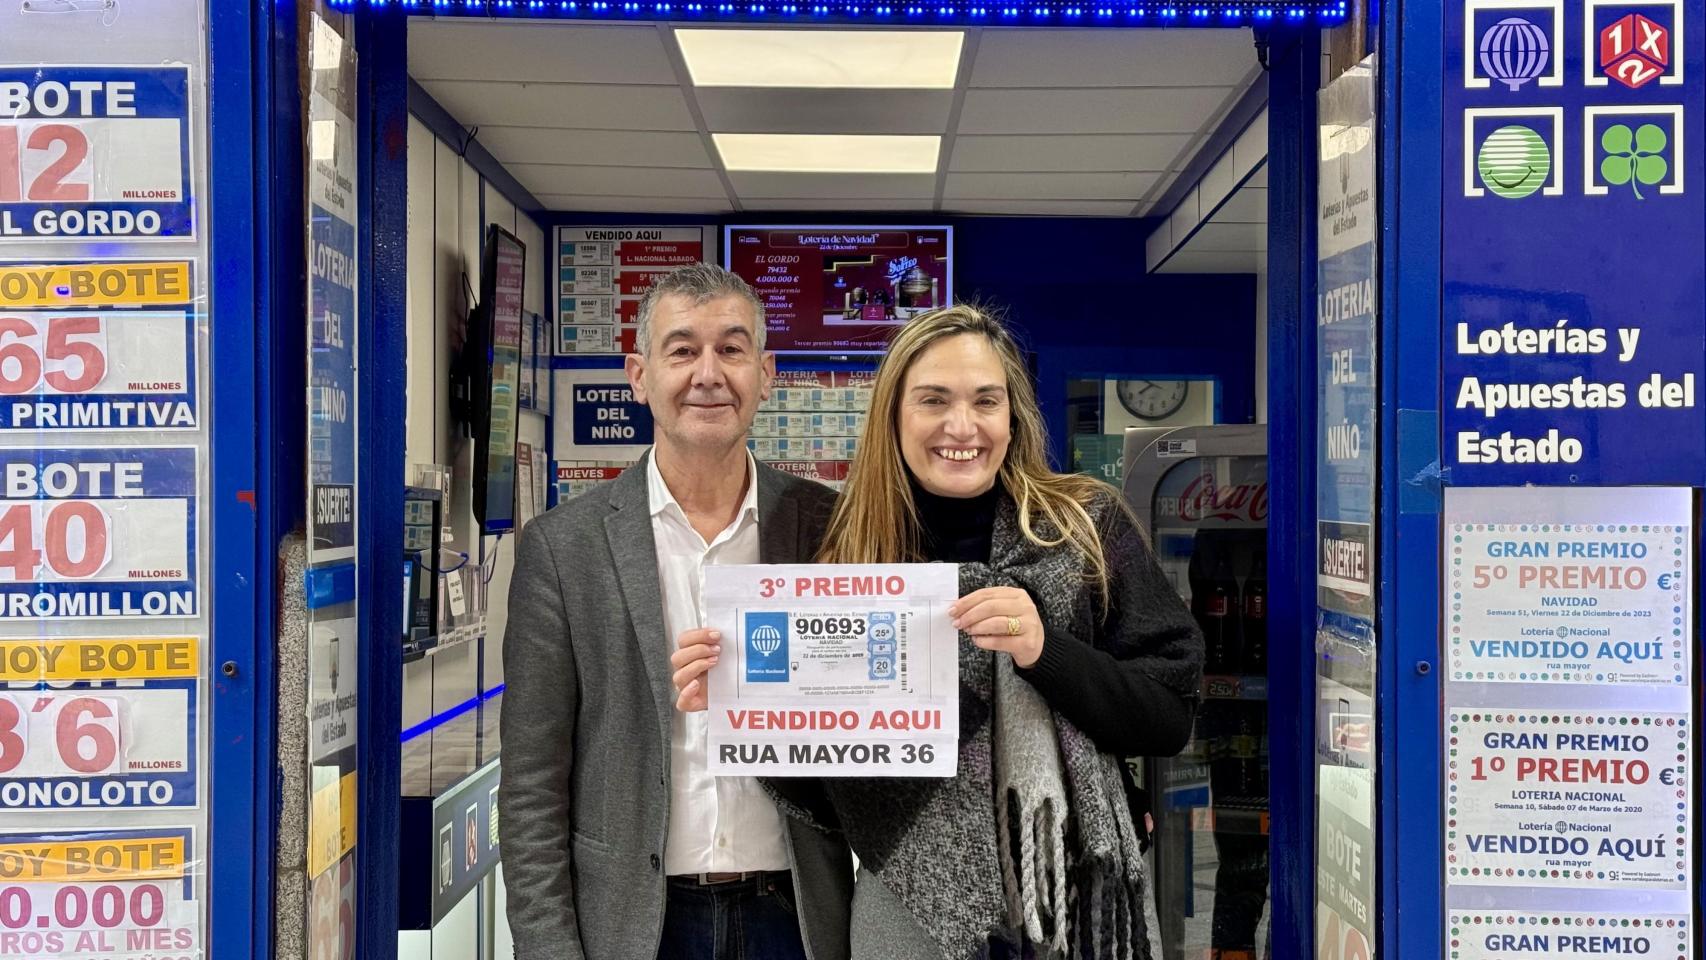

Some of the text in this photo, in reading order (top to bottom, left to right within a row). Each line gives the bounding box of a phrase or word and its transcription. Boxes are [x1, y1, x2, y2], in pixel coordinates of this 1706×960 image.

[0, 81, 137, 117] BOTE
[123, 190, 176, 198] MILLONES
[0, 210, 161, 235] L GORDO
[585, 231, 662, 240] VENDIDO AQUI
[312, 239, 355, 289] LOTERIA
[755, 255, 800, 263] EL GORDO
[71, 268, 180, 298] BOTE
[1318, 278, 1373, 326] LOTERIA
[324, 310, 344, 349] DEL
[1457, 320, 1640, 362] Loterías y
[1332, 348, 1357, 385] DEL
[128, 382, 181, 391] MILLONES
[576, 389, 634, 402] LOTER
[1456, 373, 1694, 417] Apuestas del
[321, 381, 347, 424] NIÑO
[12, 401, 195, 427] PRIMITIVA
[597, 408, 630, 420] DEL
[591, 424, 635, 439] NIÑO
[1327, 418, 1360, 460] NIÑO
[1458, 429, 1583, 464] Estado
[6, 462, 144, 498] BOTE
[558, 469, 604, 478] JUEVES
[1487, 541, 1647, 558] GRAN PREMIO
[128, 570, 182, 578] MILLONES
[1519, 565, 1647, 590] PREMIO
[1657, 573, 1672, 590] €
[759, 576, 905, 598] 3º PREMIO
[1541, 597, 1597, 607] NAVIDAD
[1486, 609, 1515, 617] Semana
[1518, 609, 1530, 618] 51,
[1531, 609, 1559, 617] Viernes
[795, 618, 866, 635] 90693
[1570, 628, 1610, 637] Nacional
[80, 642, 189, 672] BOTE
[1470, 636, 1663, 663] VENDIDO AQUÍ
[876, 661, 887, 669] 20
[1563, 663, 1591, 671] mayor
[726, 710, 941, 731] VENDIDO AQUI
[1484, 732, 1649, 751] GRAN PREMIO
[719, 743, 935, 764] RUA MAYOR 36
[128, 761, 182, 769] MILLONES
[1517, 757, 1650, 785] PREMIO
[1659, 768, 1674, 785] €
[1, 780, 173, 807] ONOLOTO
[1512, 790, 1625, 802] LOTERIA NACIONAL
[1525, 803, 1537, 811] 10,
[1538, 803, 1565, 811] Sábado
[1569, 823, 1611, 832] Nacional
[66, 842, 175, 874] BOTE
[1326, 822, 1360, 881] BOTE
[1466, 834, 1666, 861] VENDIDO AQUÍ
[1339, 883, 1366, 923] MARTES
[74, 930, 115, 952] AL
[126, 928, 193, 950] MES
[1485, 934, 1650, 954] GRAN PREMIO
